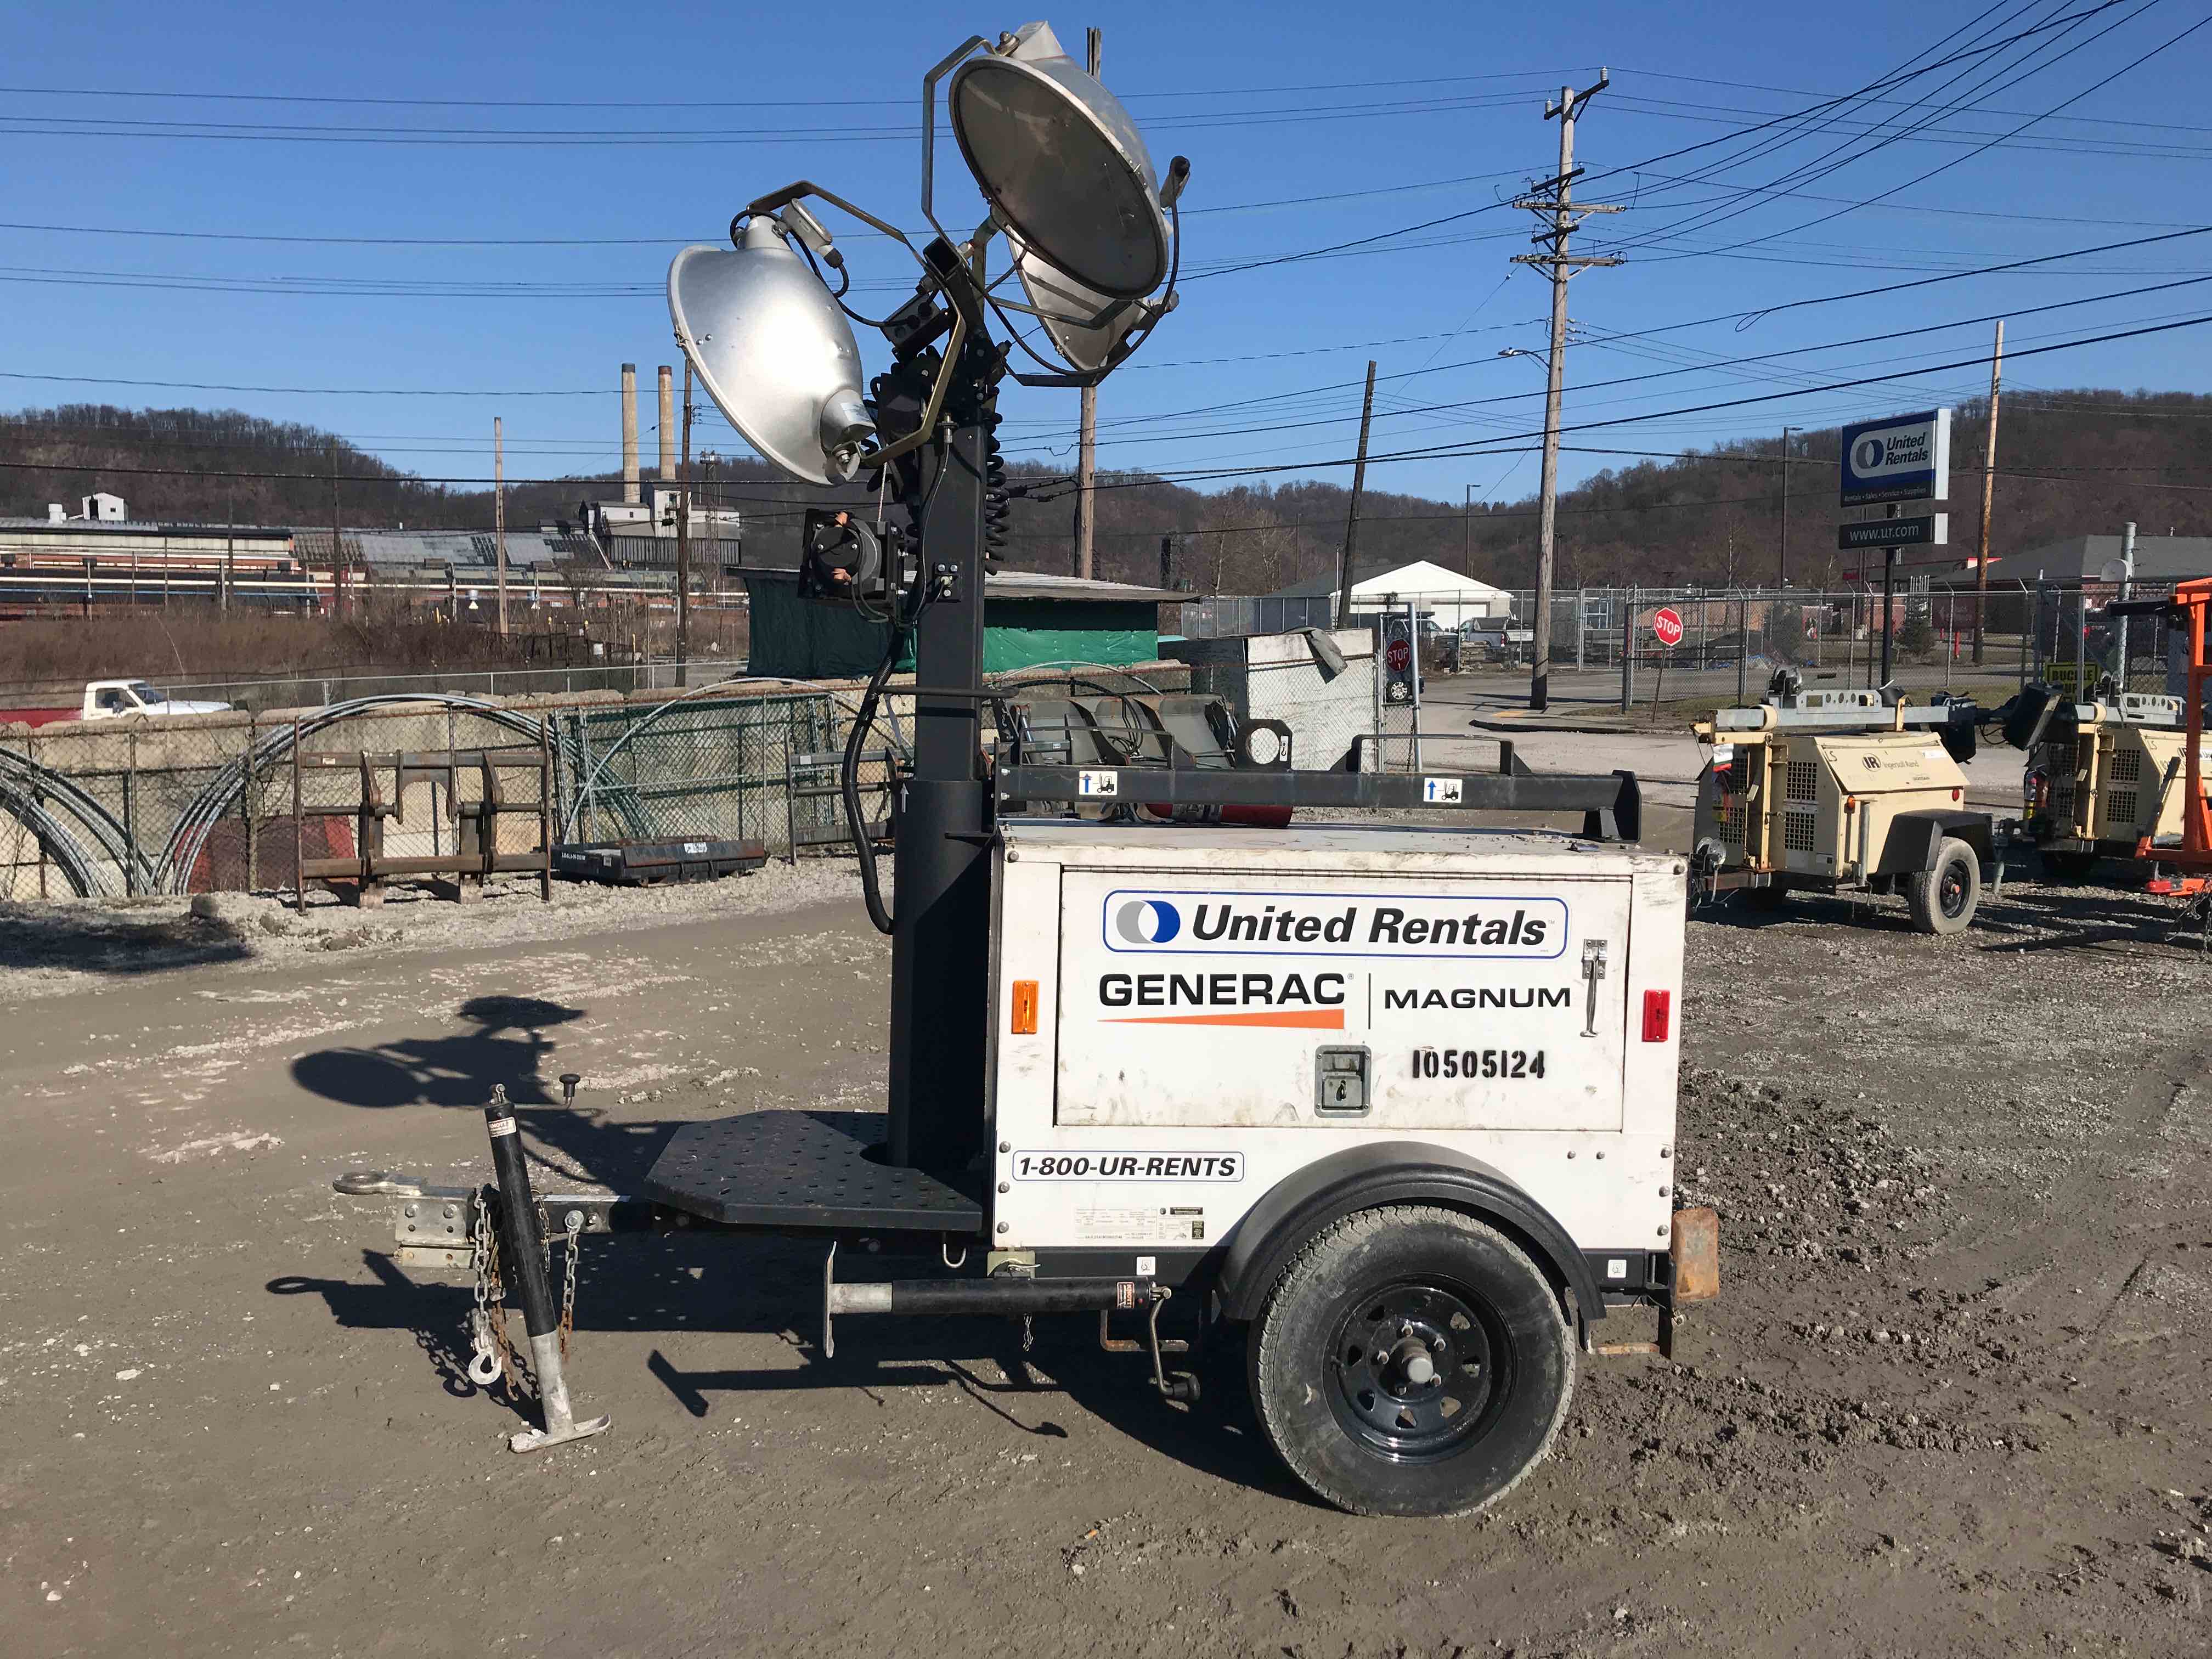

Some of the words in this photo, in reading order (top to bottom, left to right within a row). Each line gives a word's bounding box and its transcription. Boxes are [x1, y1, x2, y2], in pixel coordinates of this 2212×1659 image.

[1887, 432, 1926, 451] United
[1886, 448, 1928, 465] Rentals
[1849, 524, 1919, 541] www.ur.com
[1657, 616, 1680, 636] STOP
[1387, 647, 1409, 663] STOP
[2052, 670, 2093, 681] BUCLE
[1864, 757, 1881, 769] IR
[1193, 904, 1358, 943] United
[1368, 908, 1547, 945] Rentals
[1100, 973, 1345, 1006] GENERAC
[1385, 988, 1570, 1009] MAGNUM
[1412, 1049, 1545, 1079] 10505124
[1020, 1157, 1236, 1177] 1-800-UR-RENTS
